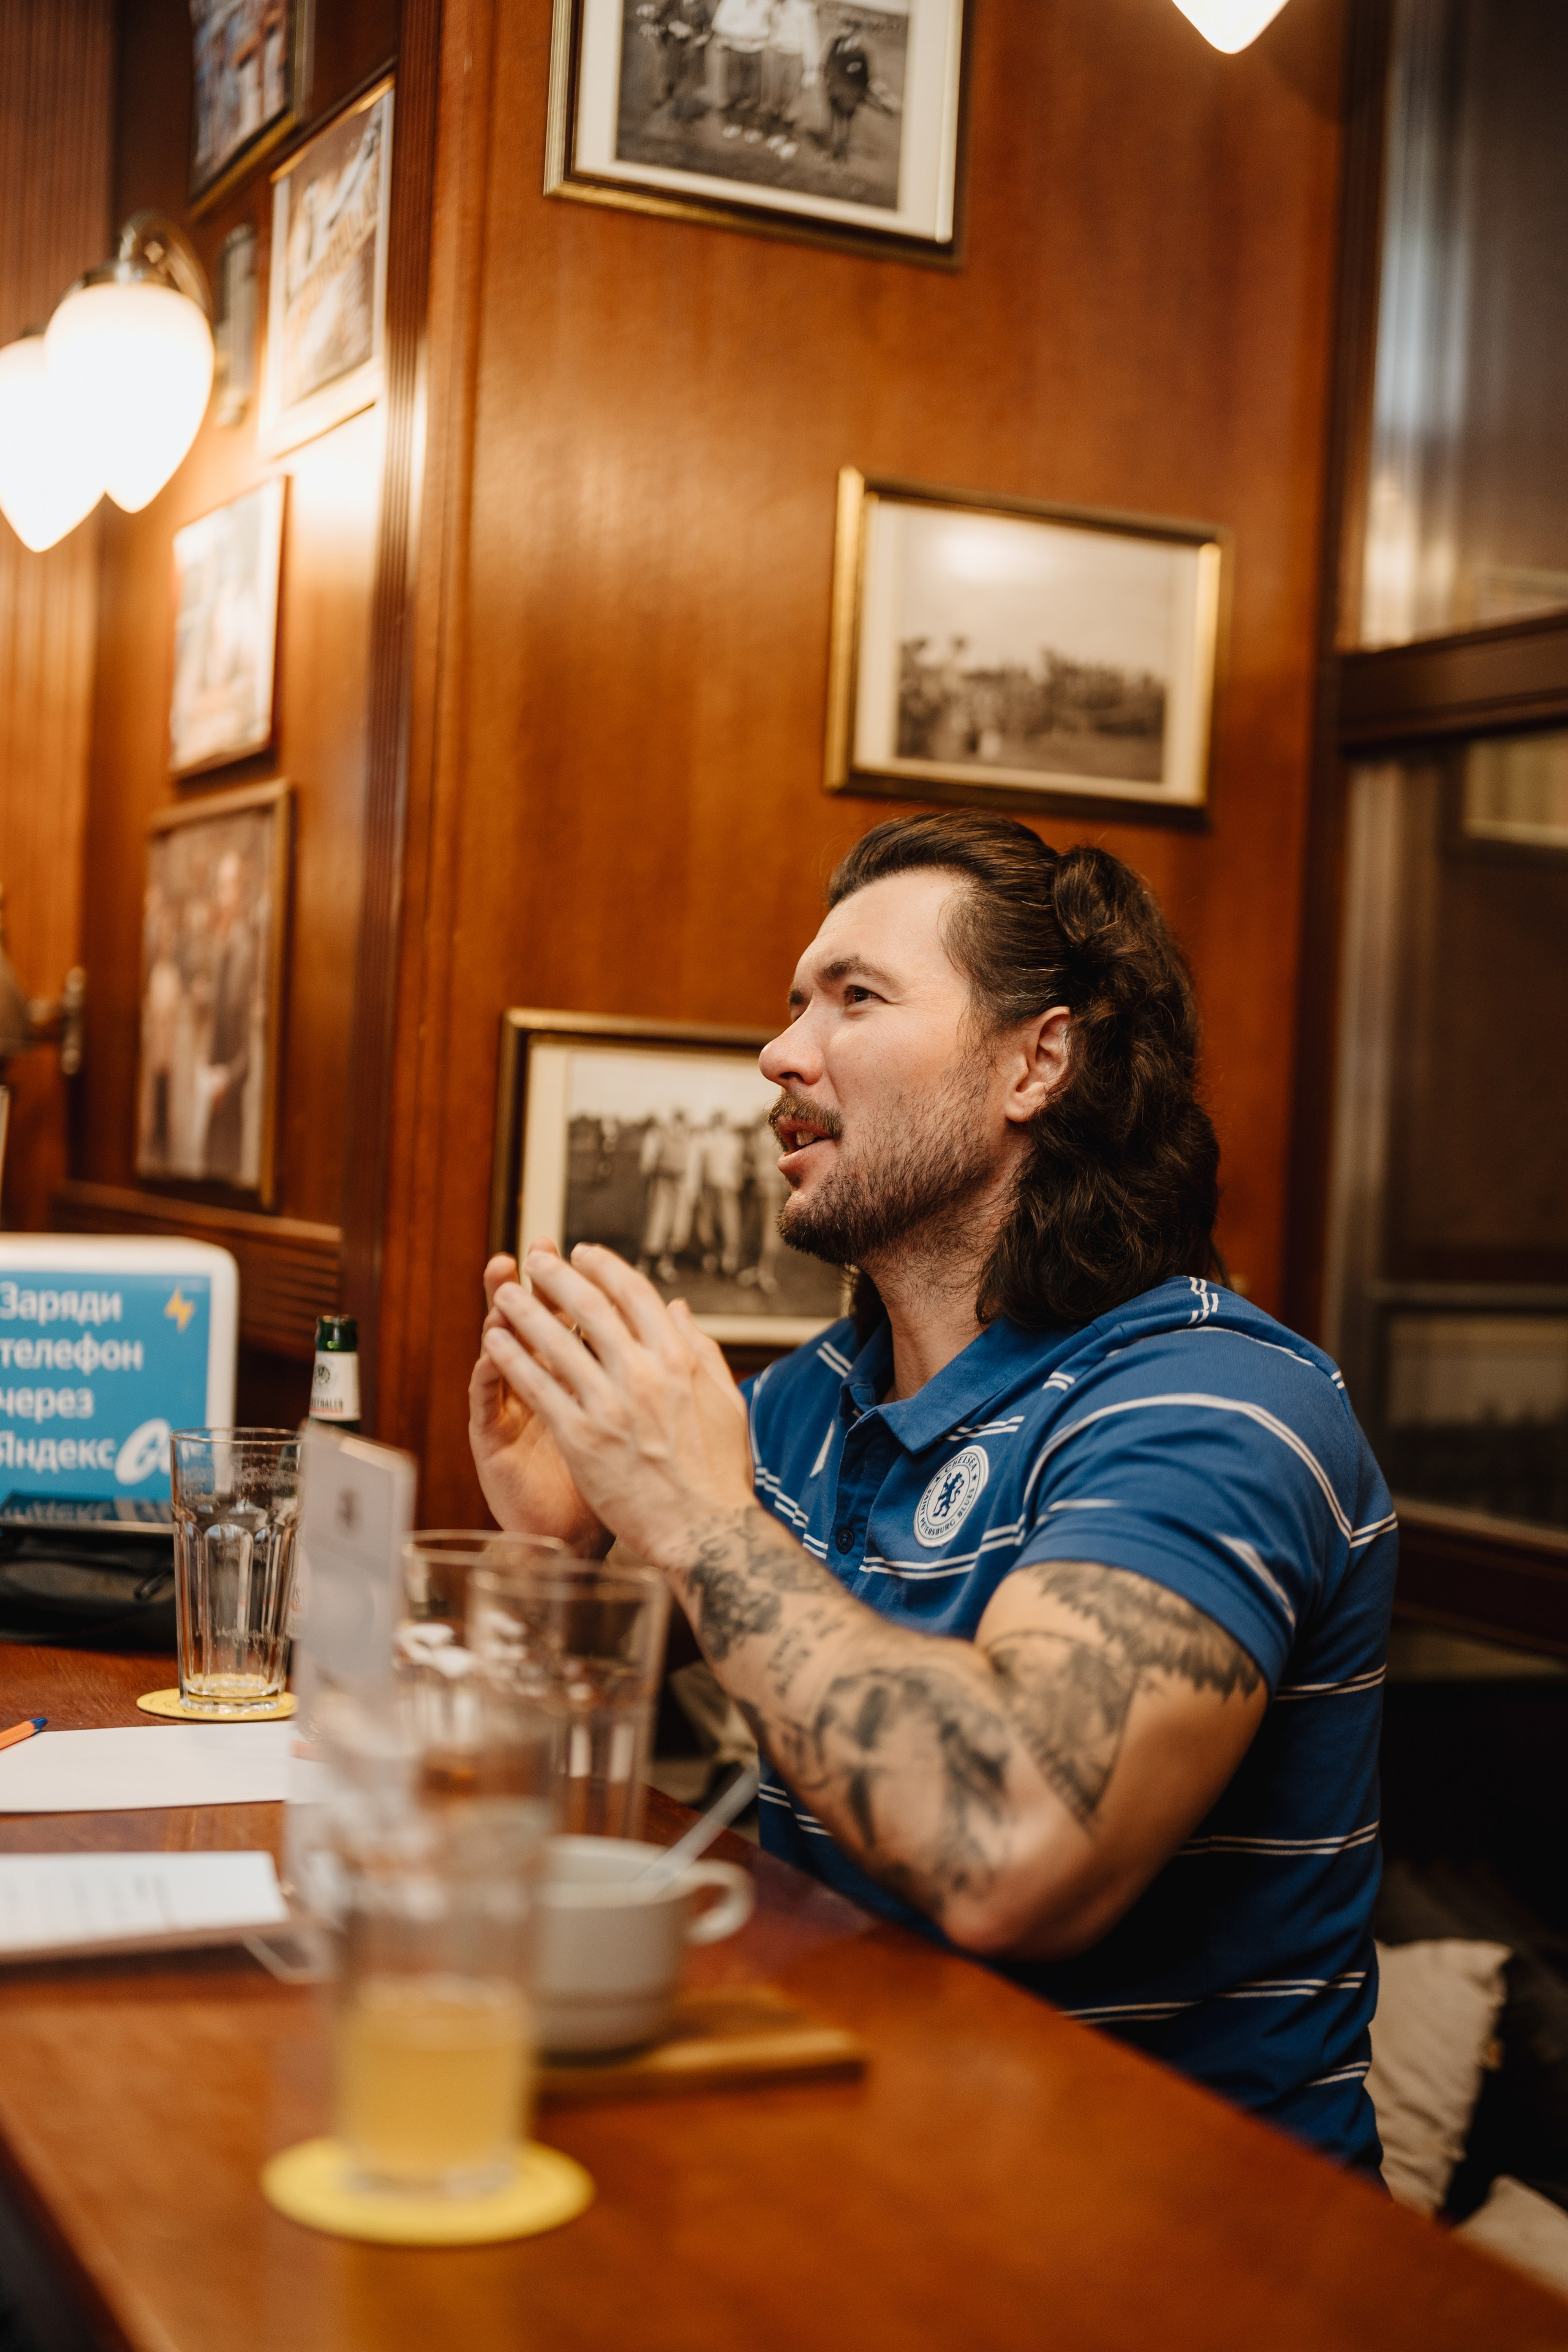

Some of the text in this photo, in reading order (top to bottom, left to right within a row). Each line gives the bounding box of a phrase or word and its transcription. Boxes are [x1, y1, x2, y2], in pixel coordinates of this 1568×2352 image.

[0, 1280, 123, 1327] Заряди
[0, 1330, 144, 1376] телефон
[945, 1455, 978, 1472] CHELSEA
[920, 1488, 974, 1535] SAINT PETERSBURG BLUES
